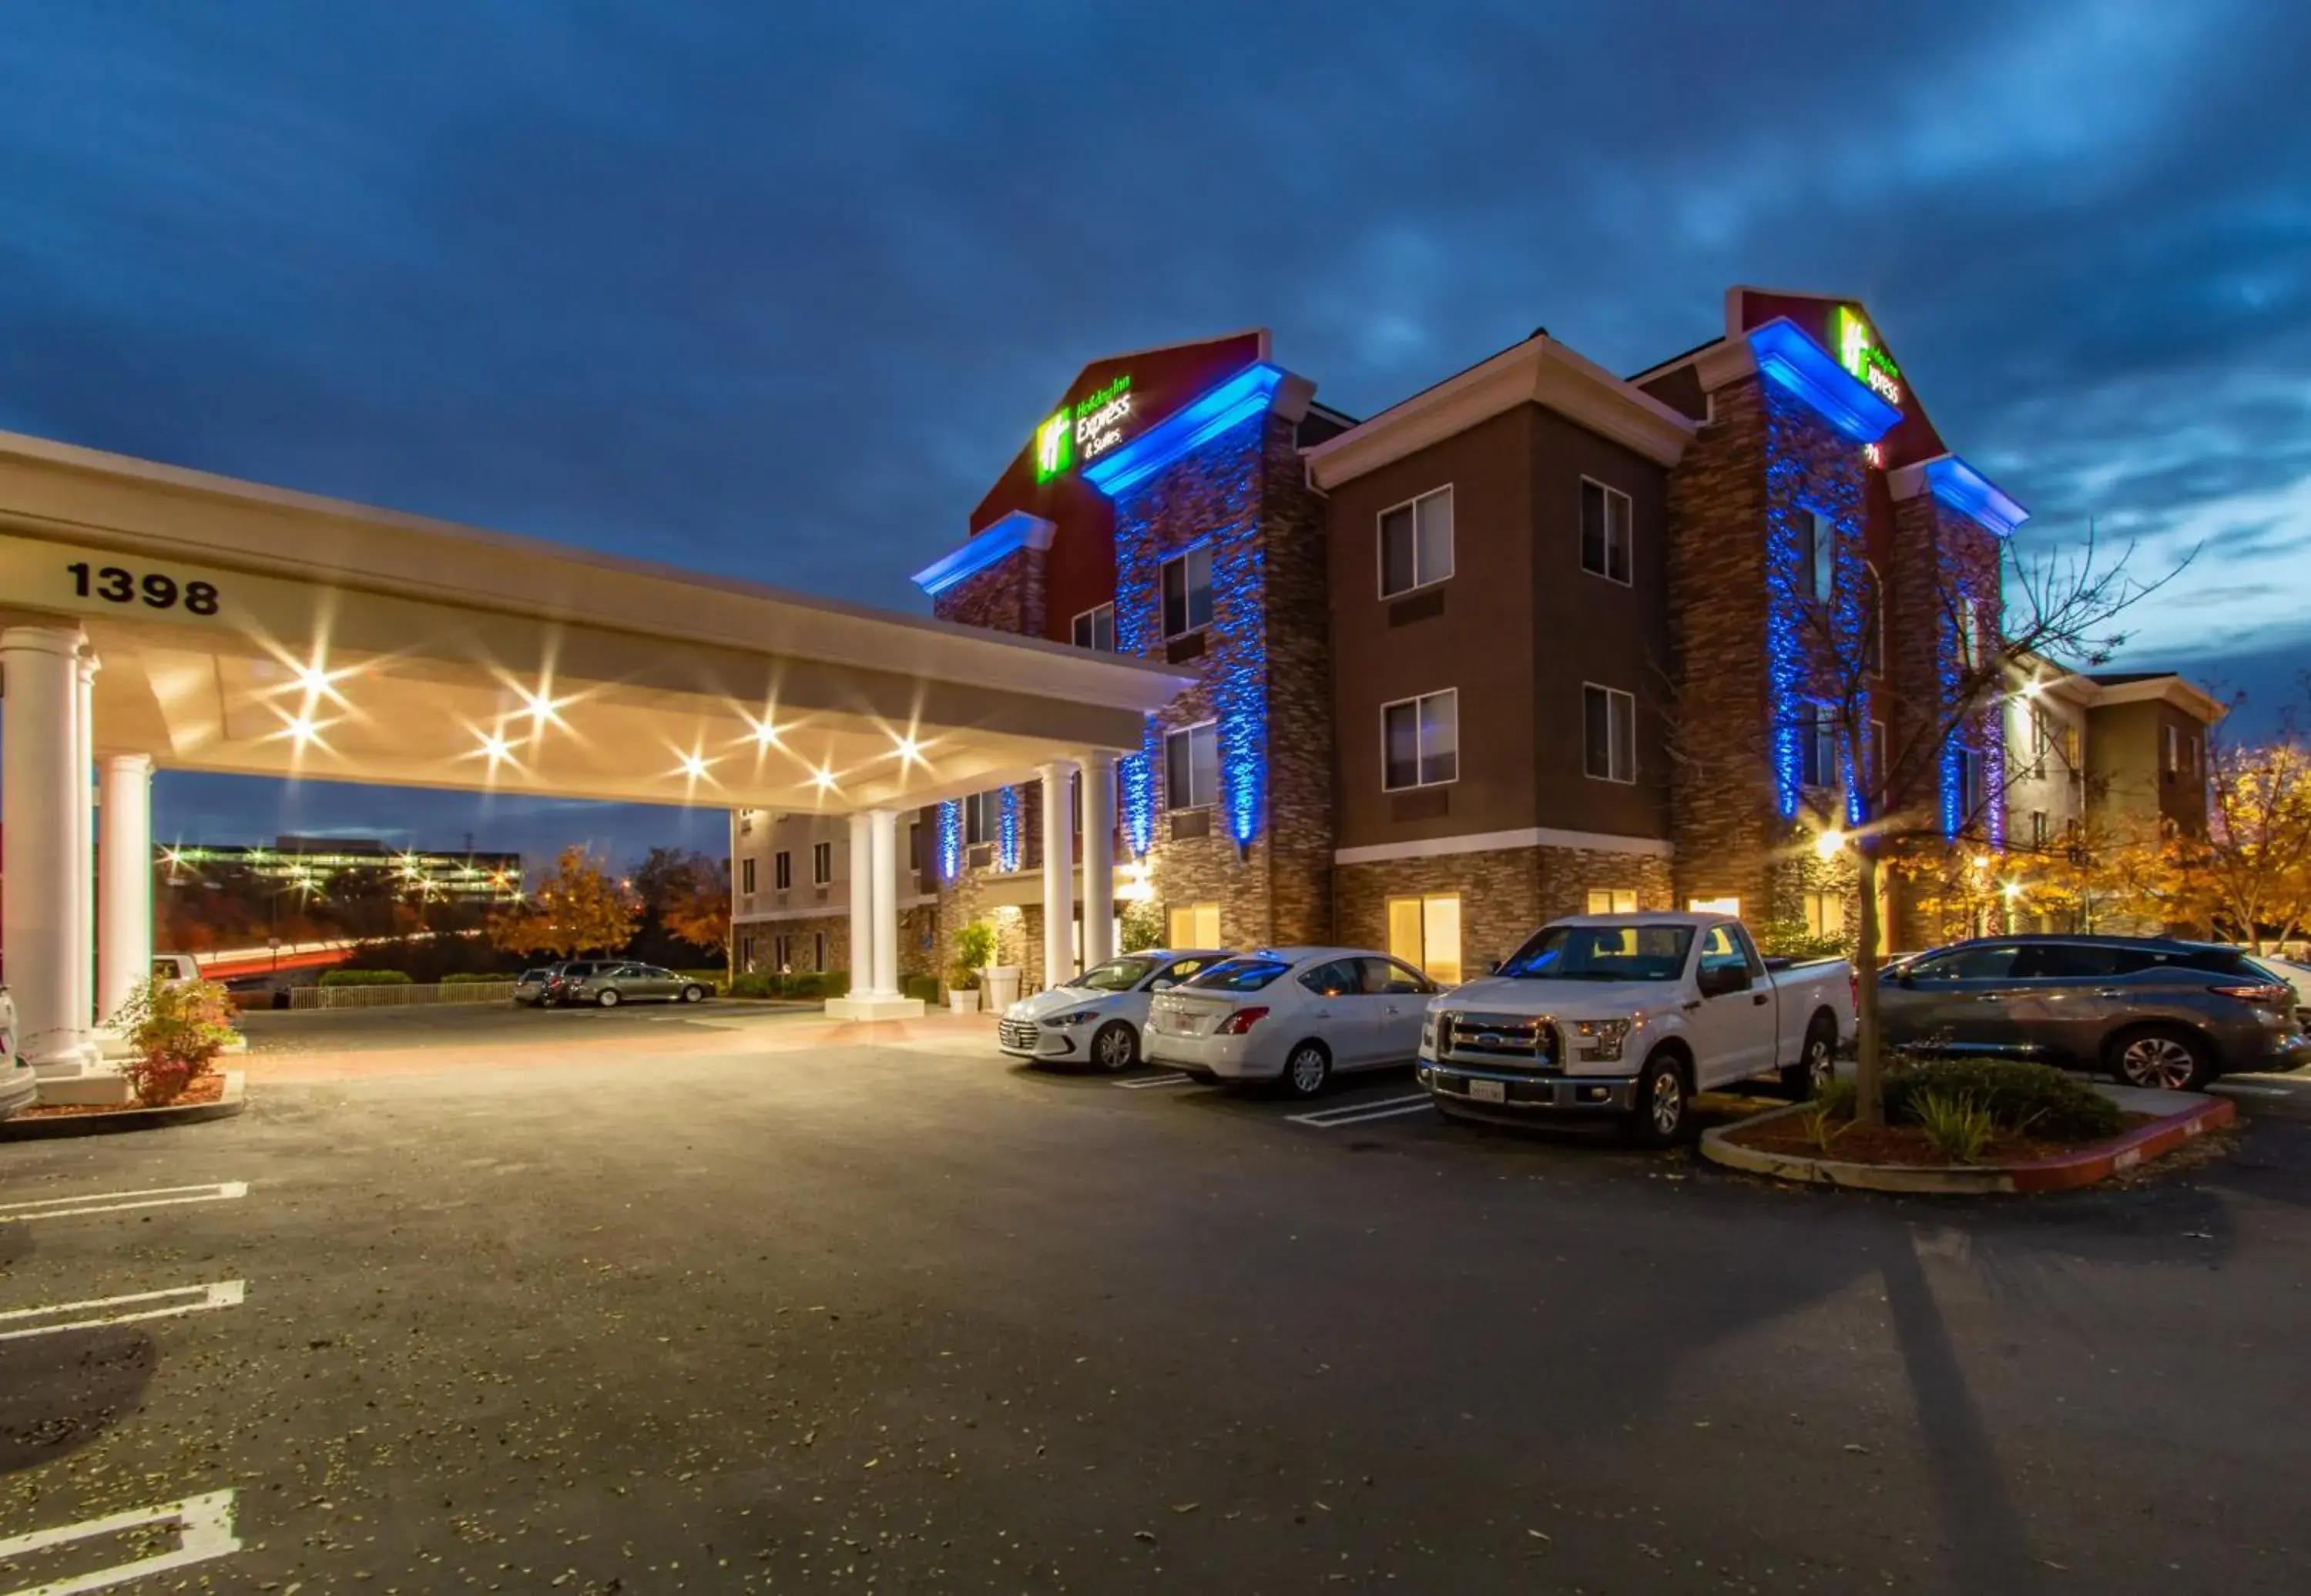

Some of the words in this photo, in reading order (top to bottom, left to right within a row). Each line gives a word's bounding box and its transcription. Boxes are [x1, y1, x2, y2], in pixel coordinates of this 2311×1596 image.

[1867, 364, 1899, 404] press
[1076, 394, 1131, 444] Express
[67, 562, 220, 615] 1398
